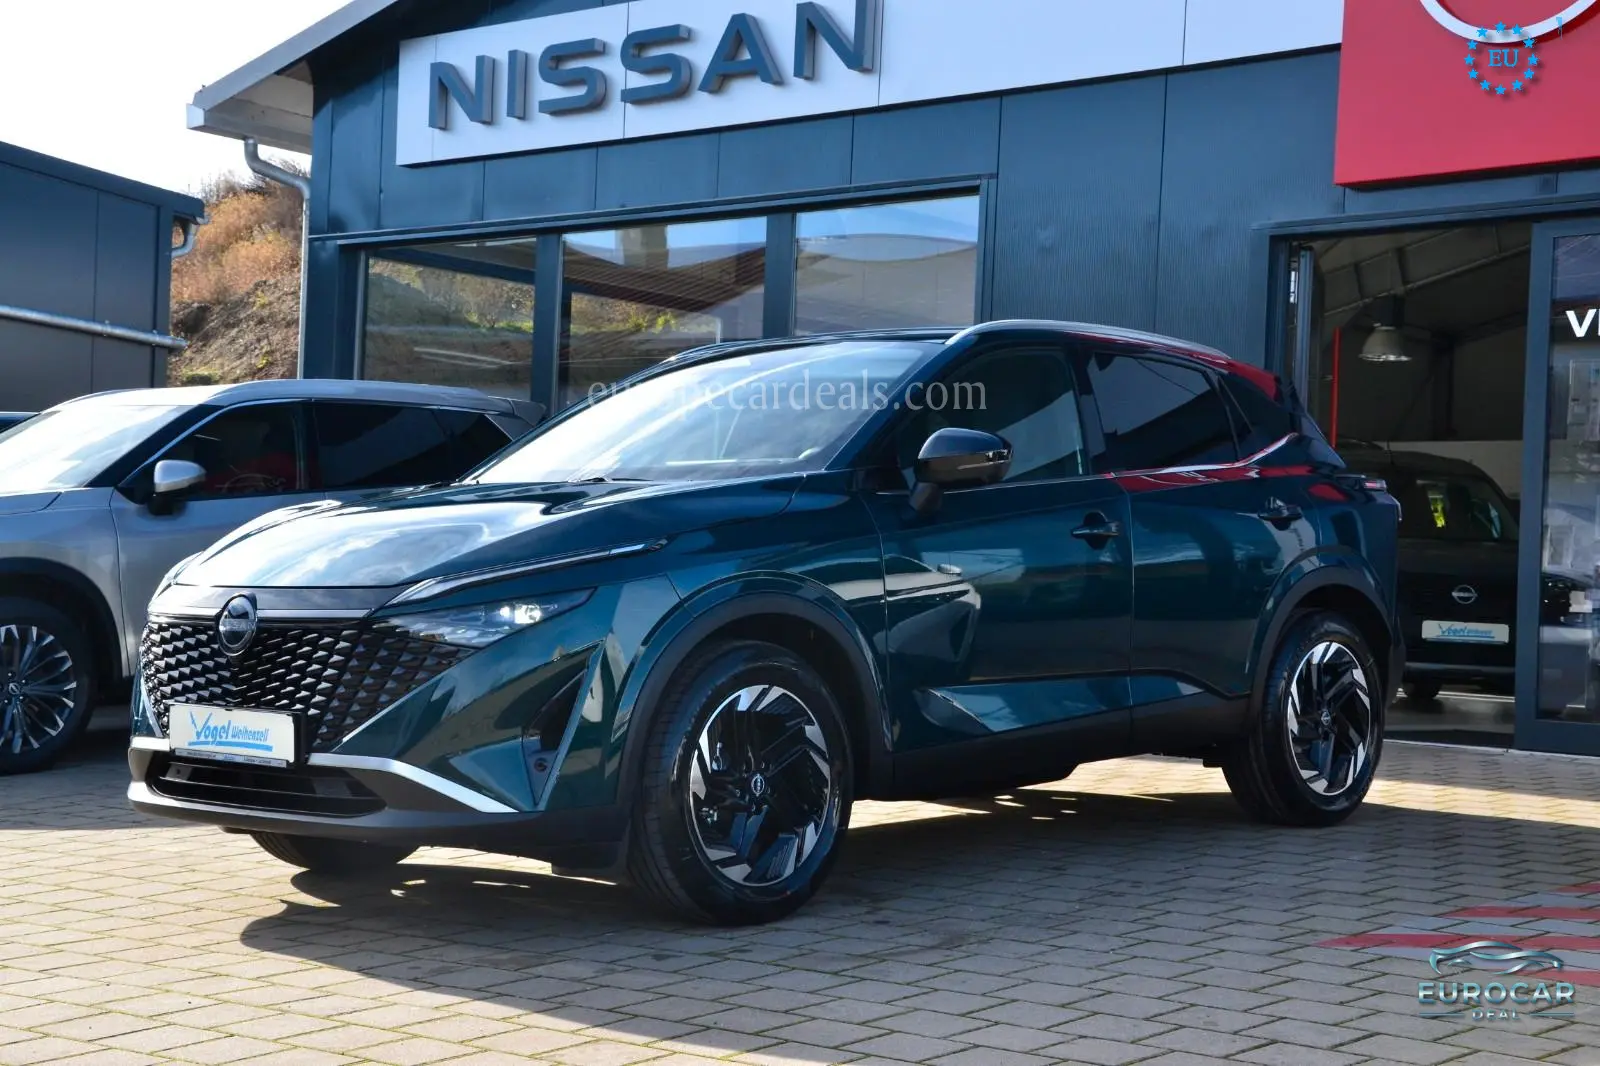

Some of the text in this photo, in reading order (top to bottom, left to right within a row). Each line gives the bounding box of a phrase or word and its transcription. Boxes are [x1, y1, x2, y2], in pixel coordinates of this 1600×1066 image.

[428, 0, 876, 130] NISSAN
[1565, 308, 1600, 338] V
[190, 711, 231, 745] Vogel
